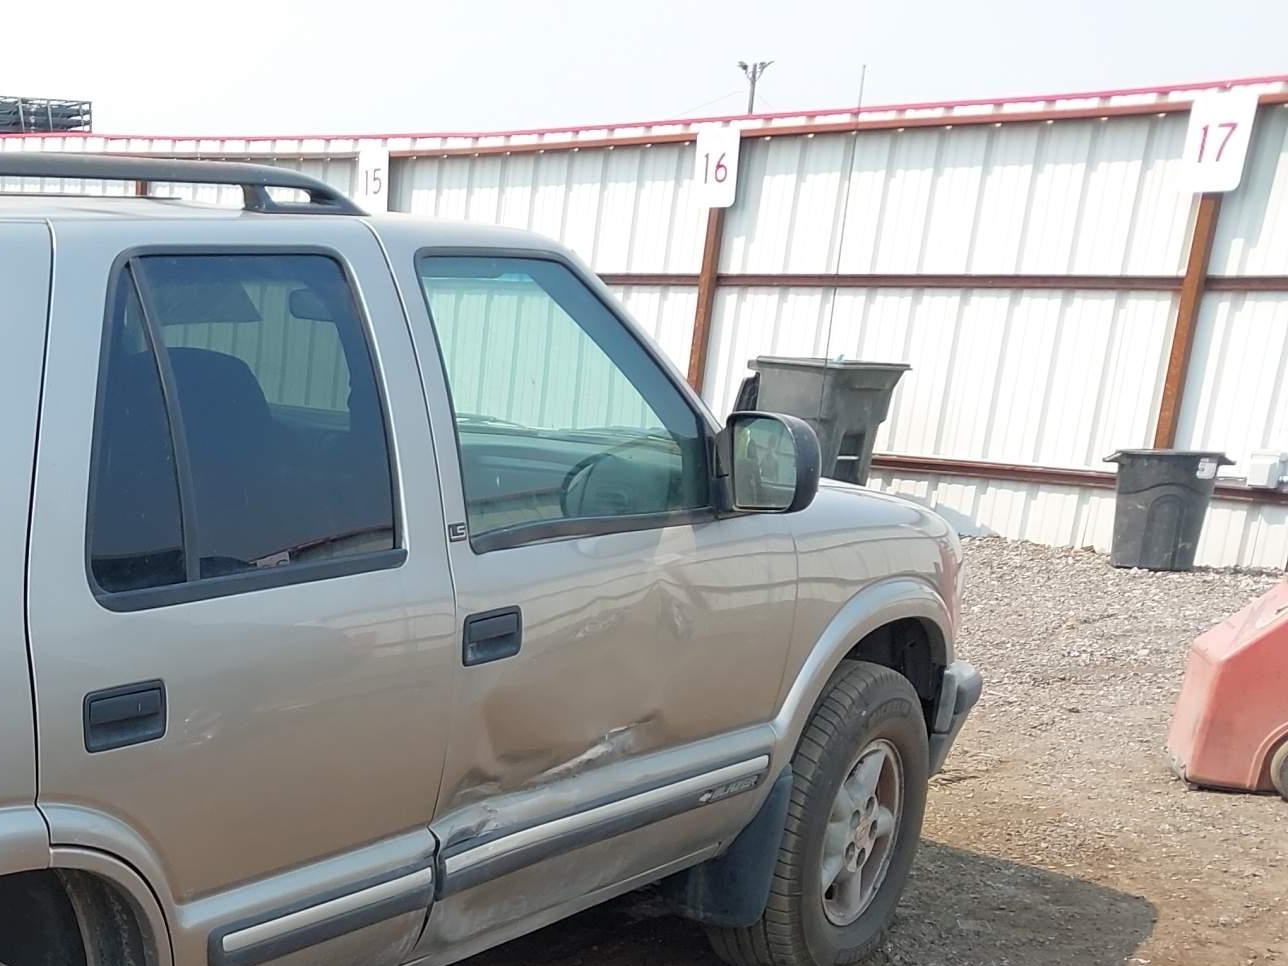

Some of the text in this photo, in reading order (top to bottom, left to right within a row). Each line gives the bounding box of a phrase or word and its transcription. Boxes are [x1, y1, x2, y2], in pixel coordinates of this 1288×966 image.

[1197, 122, 1238, 163] 17
[364, 167, 382, 197] 15
[704, 151, 728, 184] 16
[449, 525, 466, 539] LS
